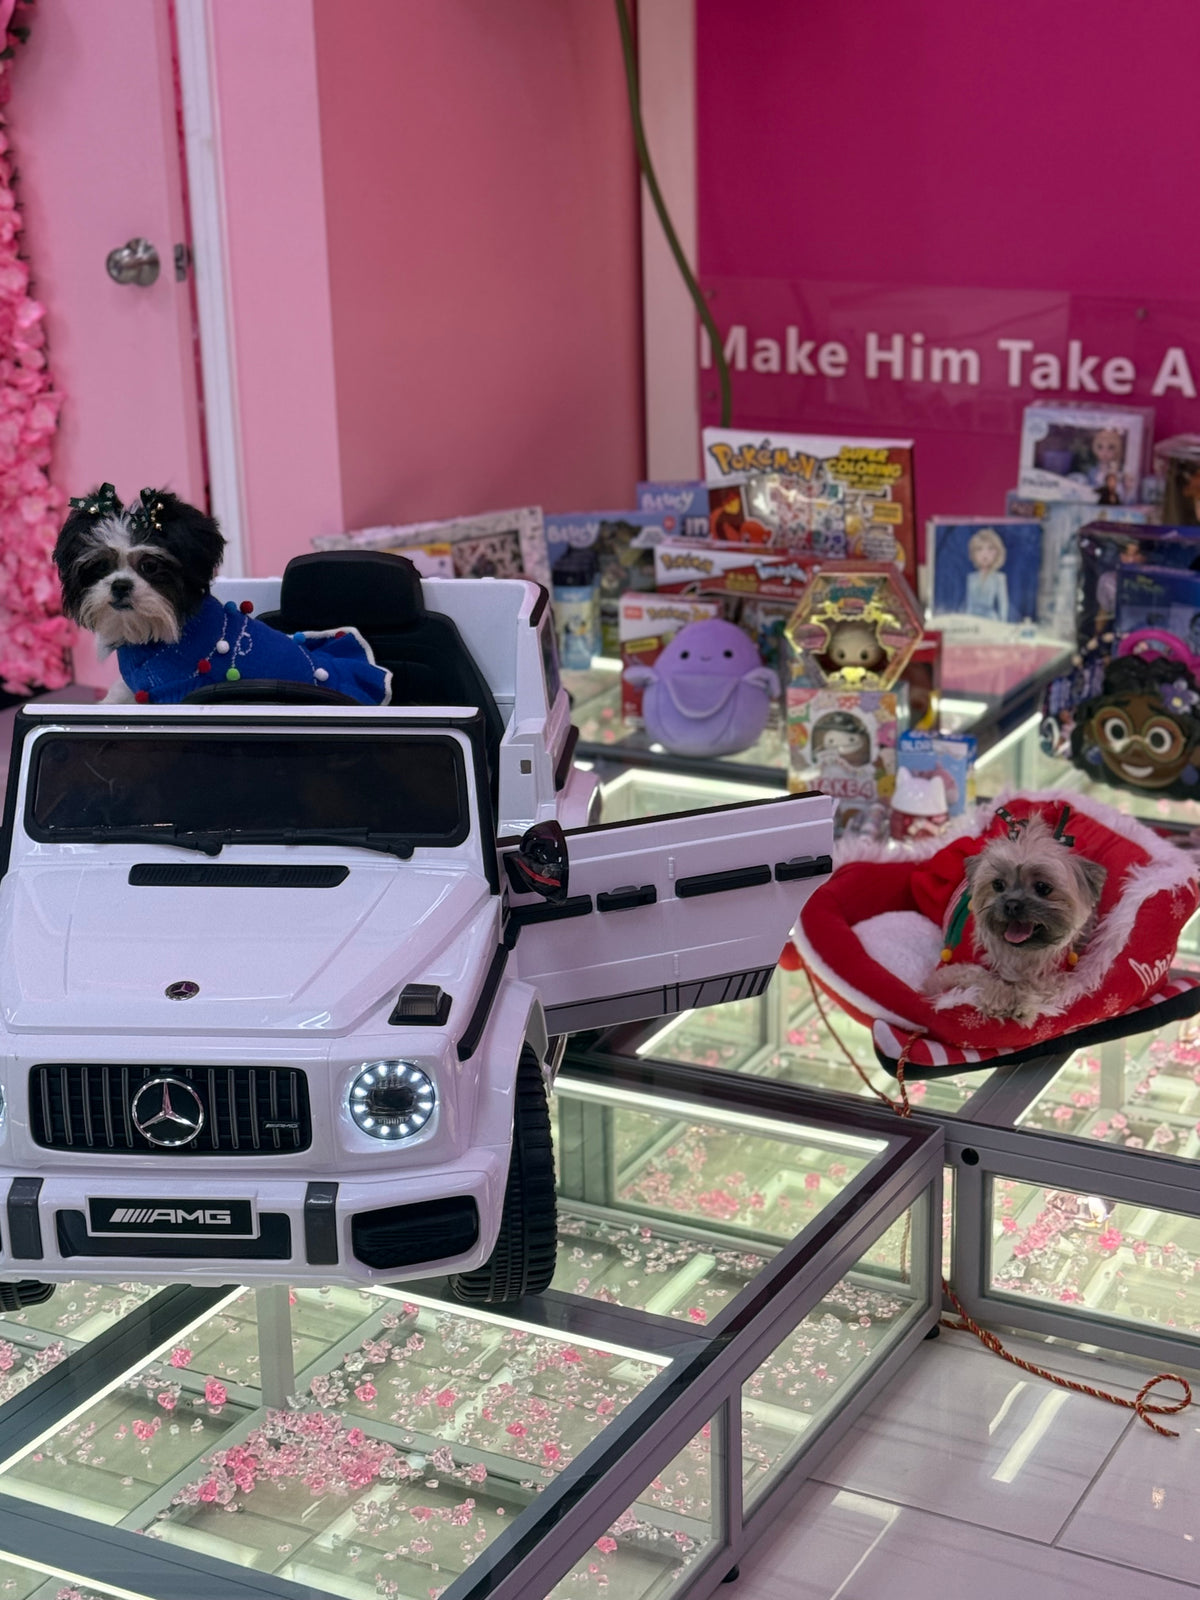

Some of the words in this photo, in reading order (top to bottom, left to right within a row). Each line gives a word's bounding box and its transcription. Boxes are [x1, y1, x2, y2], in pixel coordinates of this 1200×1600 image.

[700, 325, 849, 377] Make
[866, 332, 980, 385] Him
[998, 338, 1135, 395] Take
[1151, 346, 1197, 398] A
[839, 445, 889, 463] SUPER
[826, 458, 902, 478] COLORING
[151, 1208, 231, 1225] AMG
